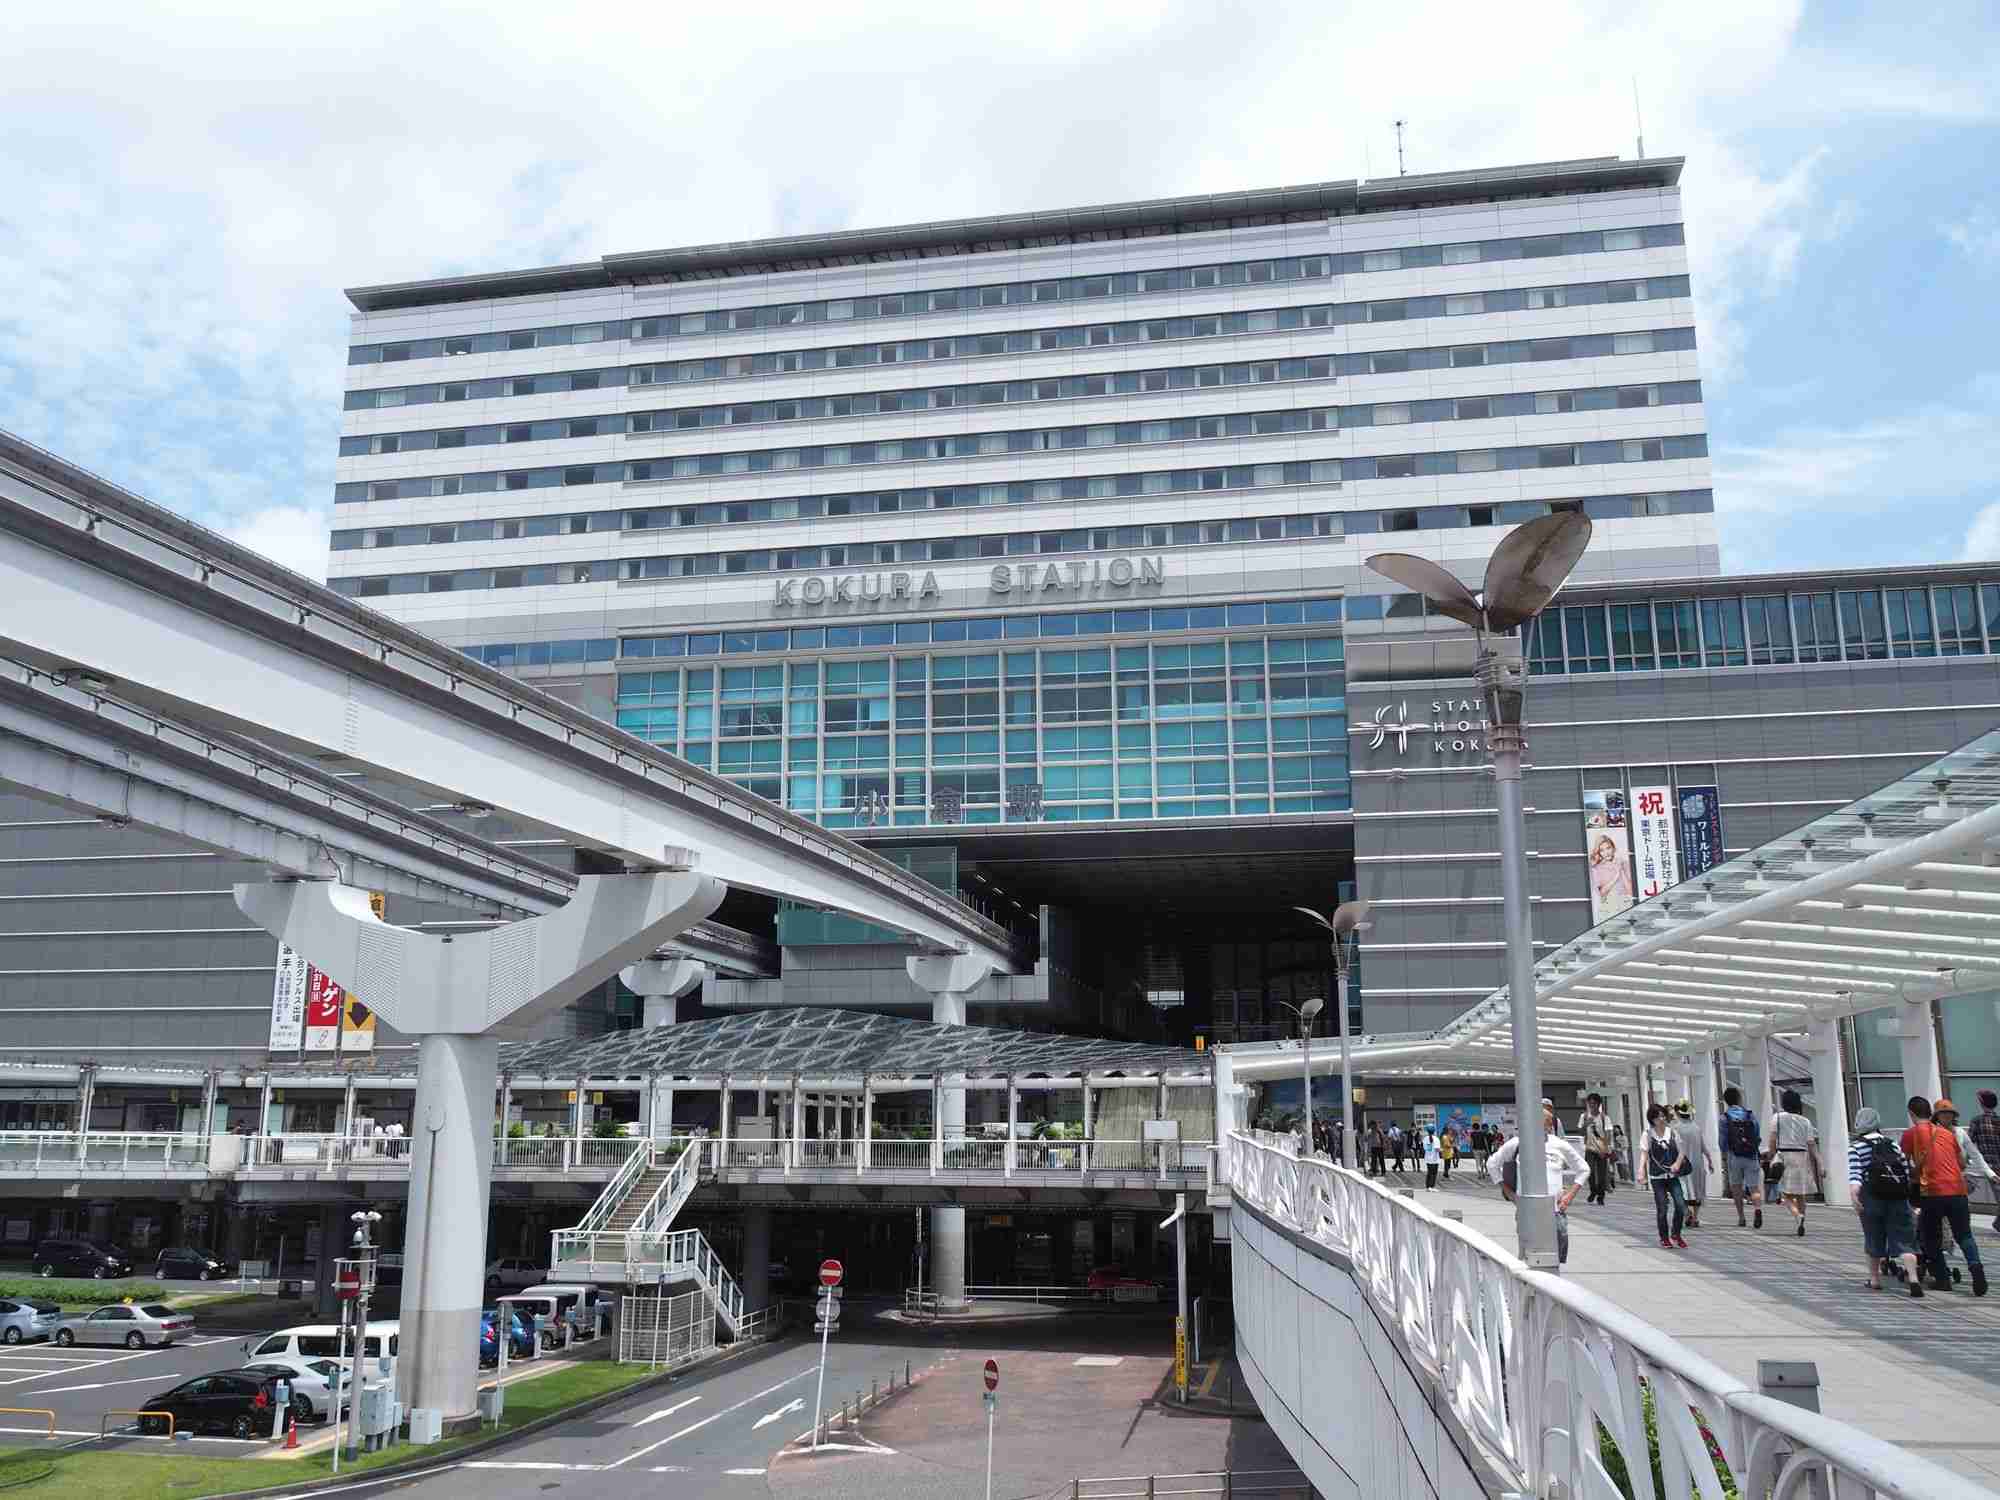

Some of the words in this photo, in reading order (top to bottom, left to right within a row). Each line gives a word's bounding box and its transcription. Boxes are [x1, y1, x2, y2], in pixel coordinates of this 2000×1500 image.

[774, 570, 943, 607] KOKURA
[990, 556, 1164, 593] STATION
[1432, 700, 1484, 713] STAT
[1433, 720, 1488, 732] HOT
[1638, 792, 1665, 816] 祝
